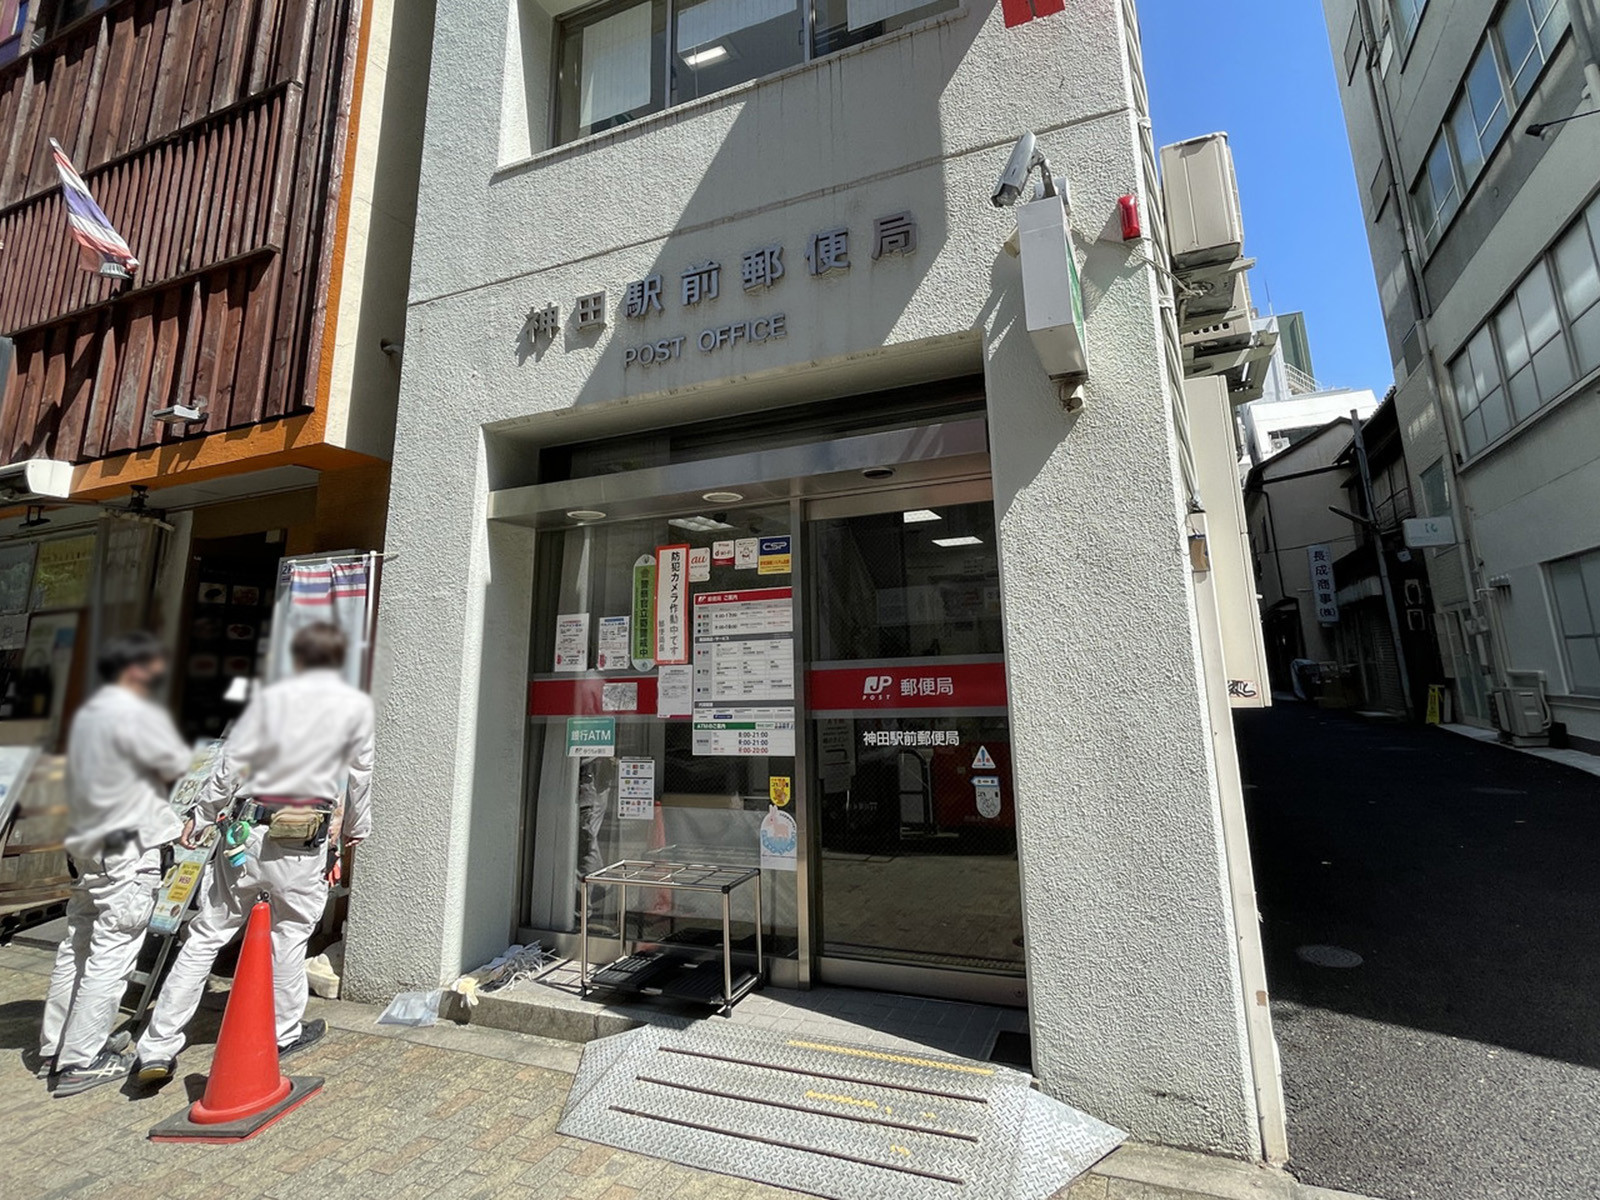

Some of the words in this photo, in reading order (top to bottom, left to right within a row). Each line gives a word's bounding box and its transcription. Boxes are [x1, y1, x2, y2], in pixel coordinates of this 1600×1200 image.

[525, 209, 918, 344] 神田駅前郵便局
[623, 335, 686, 368] POST
[697, 313, 787, 353] OFFICE
[762, 541, 788, 551] CSP
[691, 555, 706, 565] au
[669, 551, 681, 655] 防犯カメラ作動中です
[900, 676, 954, 697] 郵便局
[570, 729, 611, 741] 銀行ATM
[862, 730, 960, 746] 神田駅前郵便局
